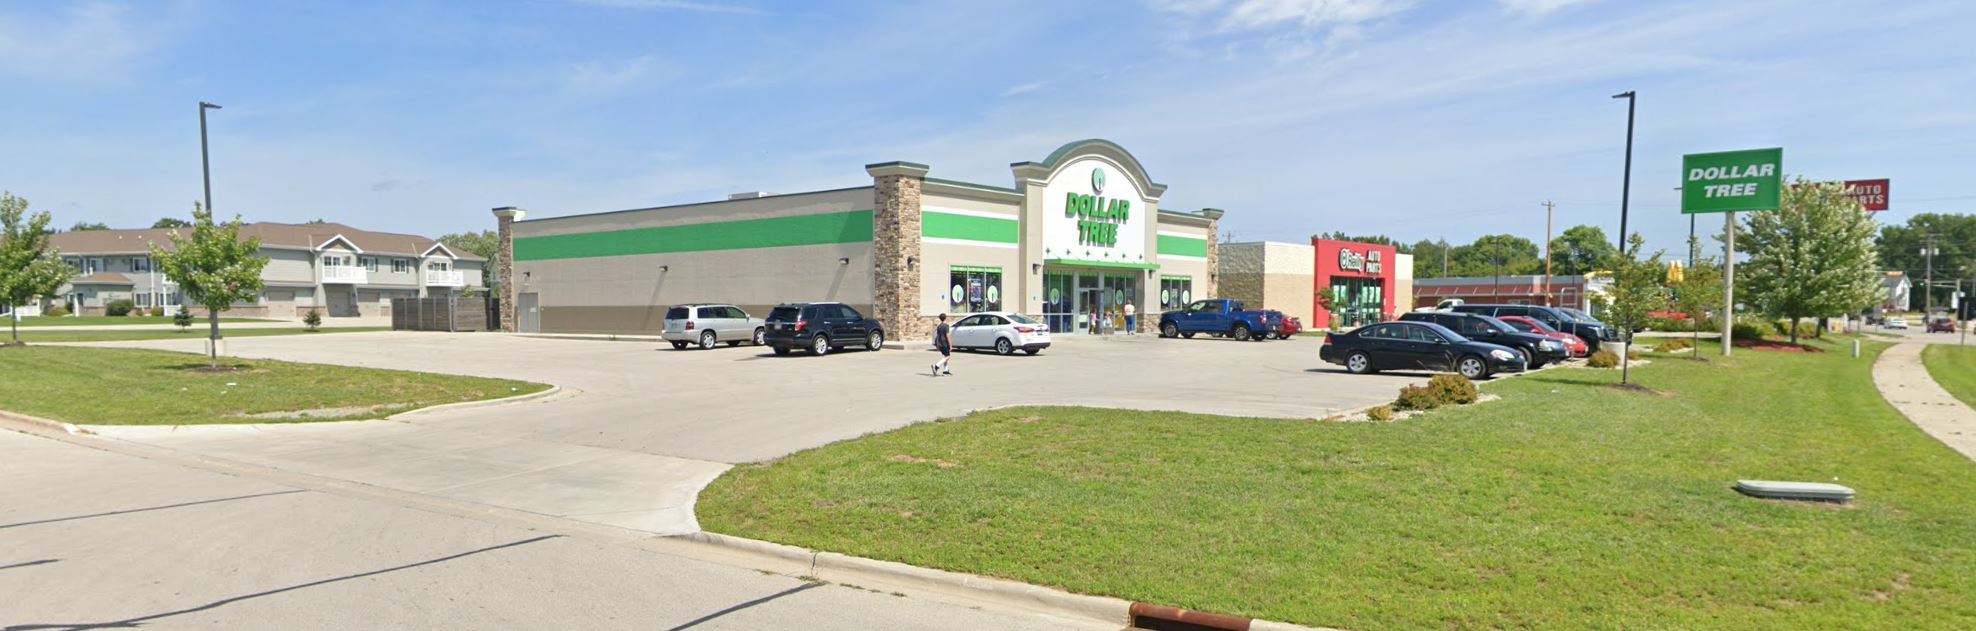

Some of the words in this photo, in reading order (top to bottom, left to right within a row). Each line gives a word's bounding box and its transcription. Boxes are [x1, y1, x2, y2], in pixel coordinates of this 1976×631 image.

[1688, 163, 1775, 181] DOLLAR
[1704, 182, 1758, 198] TREE
[1065, 192, 1130, 222] DOLLAR
[1077, 220, 1118, 245] TREE
[1367, 250, 1381, 261] AUTO
[1366, 261, 1382, 273] PARTS
